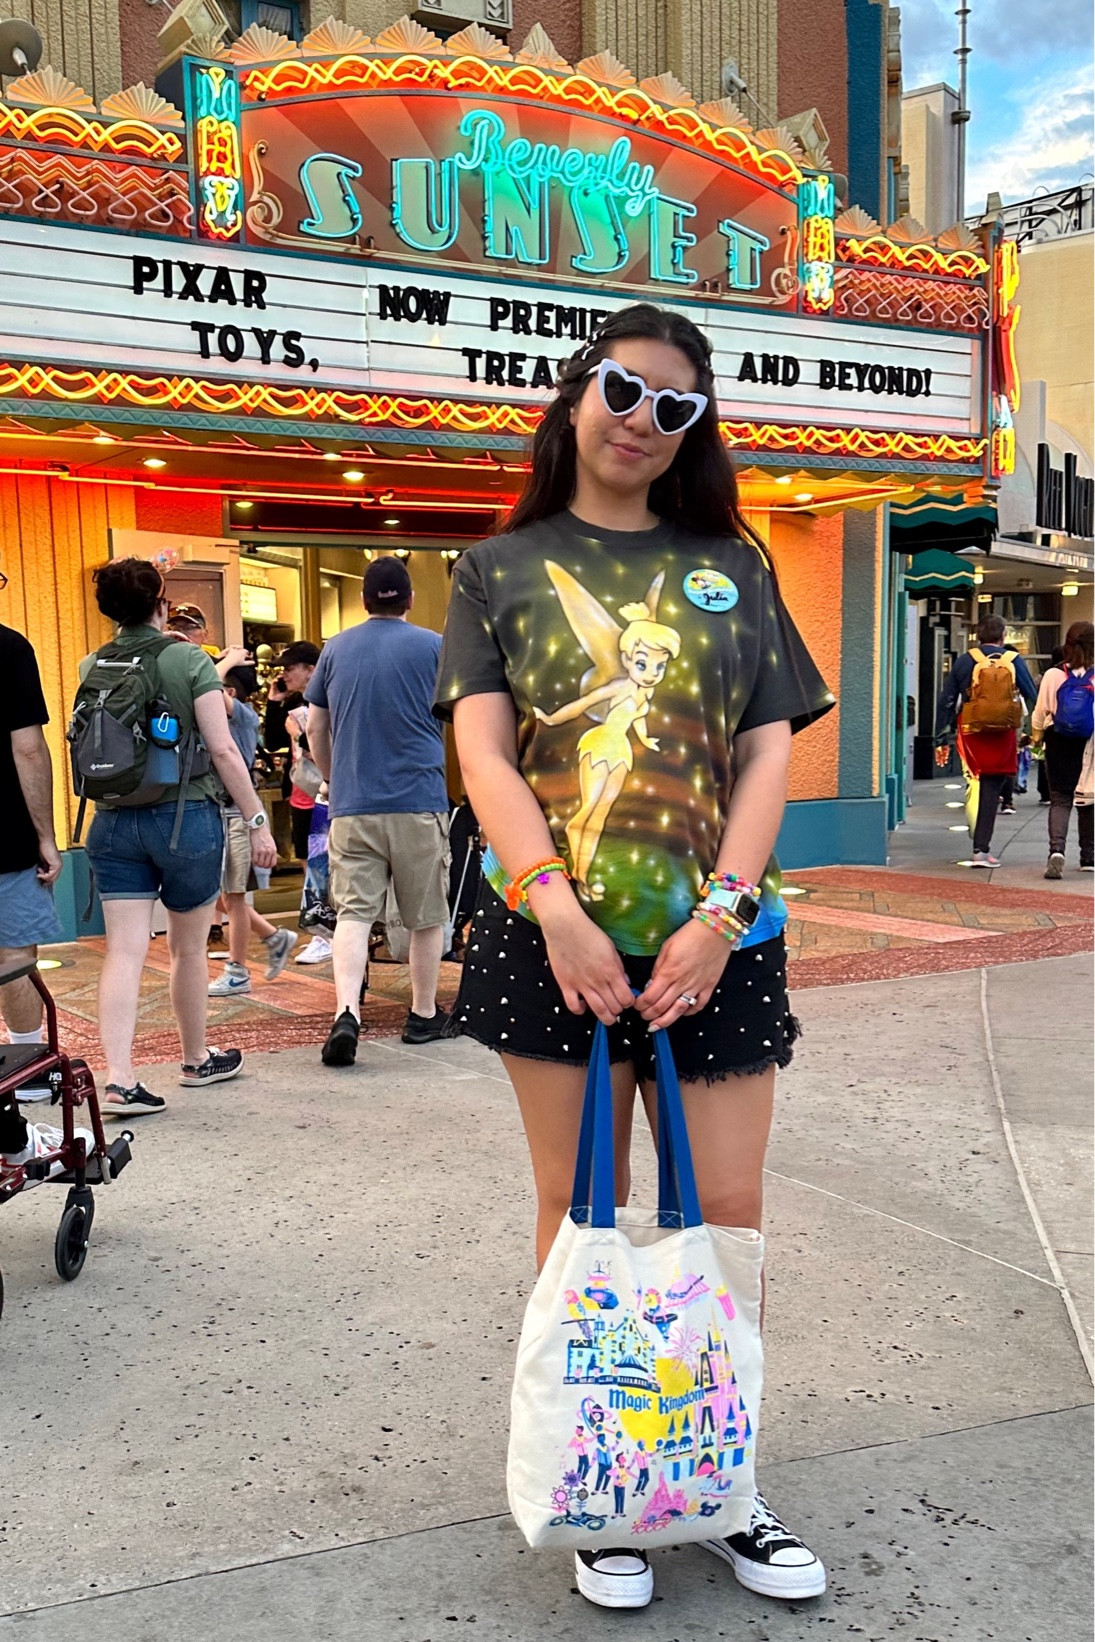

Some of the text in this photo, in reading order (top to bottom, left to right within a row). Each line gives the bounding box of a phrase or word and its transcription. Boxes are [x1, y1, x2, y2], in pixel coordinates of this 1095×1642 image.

[455, 109, 659, 217] Beverly
[297, 151, 771, 290] SUNSET
[132, 254, 614, 341] PIXAR NOW PREMIE
[190, 320, 320, 373] TOYS,
[737, 352, 800, 387] AND
[819, 359, 932, 398] BEYOND!
[703, 591, 728, 605] Julia
[609, 1388, 705, 1414] Magic Kingdom
